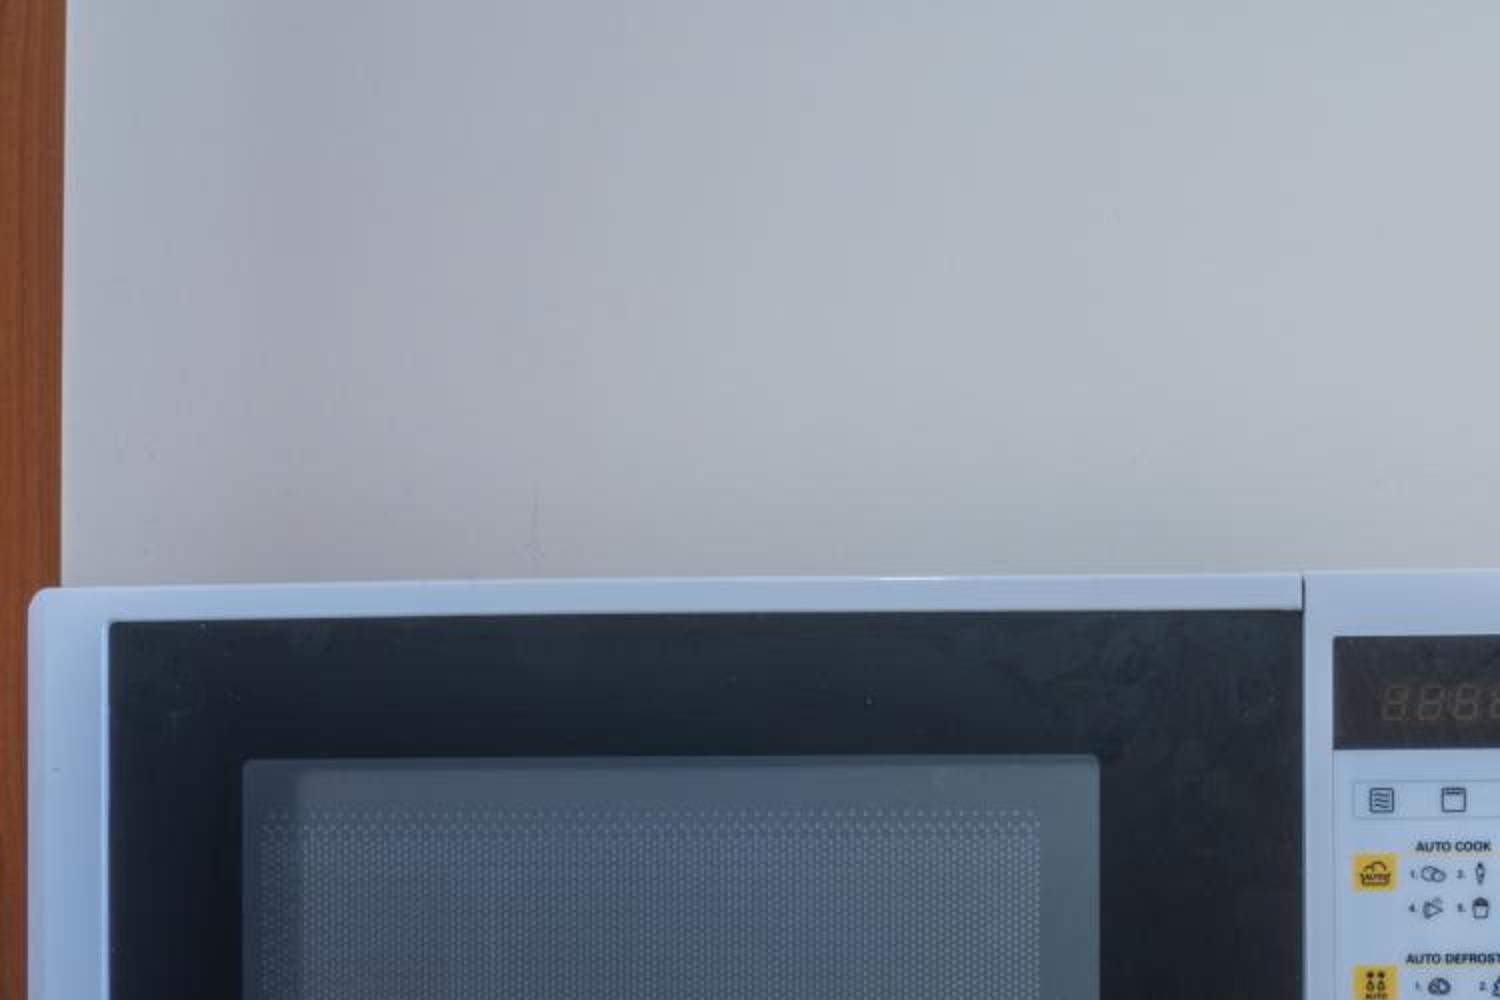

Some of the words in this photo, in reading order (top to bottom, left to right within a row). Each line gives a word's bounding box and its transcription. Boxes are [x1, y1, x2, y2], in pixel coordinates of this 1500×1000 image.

[1415, 841, 1450, 852] AUTO
[1455, 840, 1492, 852] COOK
[1406, 953, 1441, 964] AUTO
